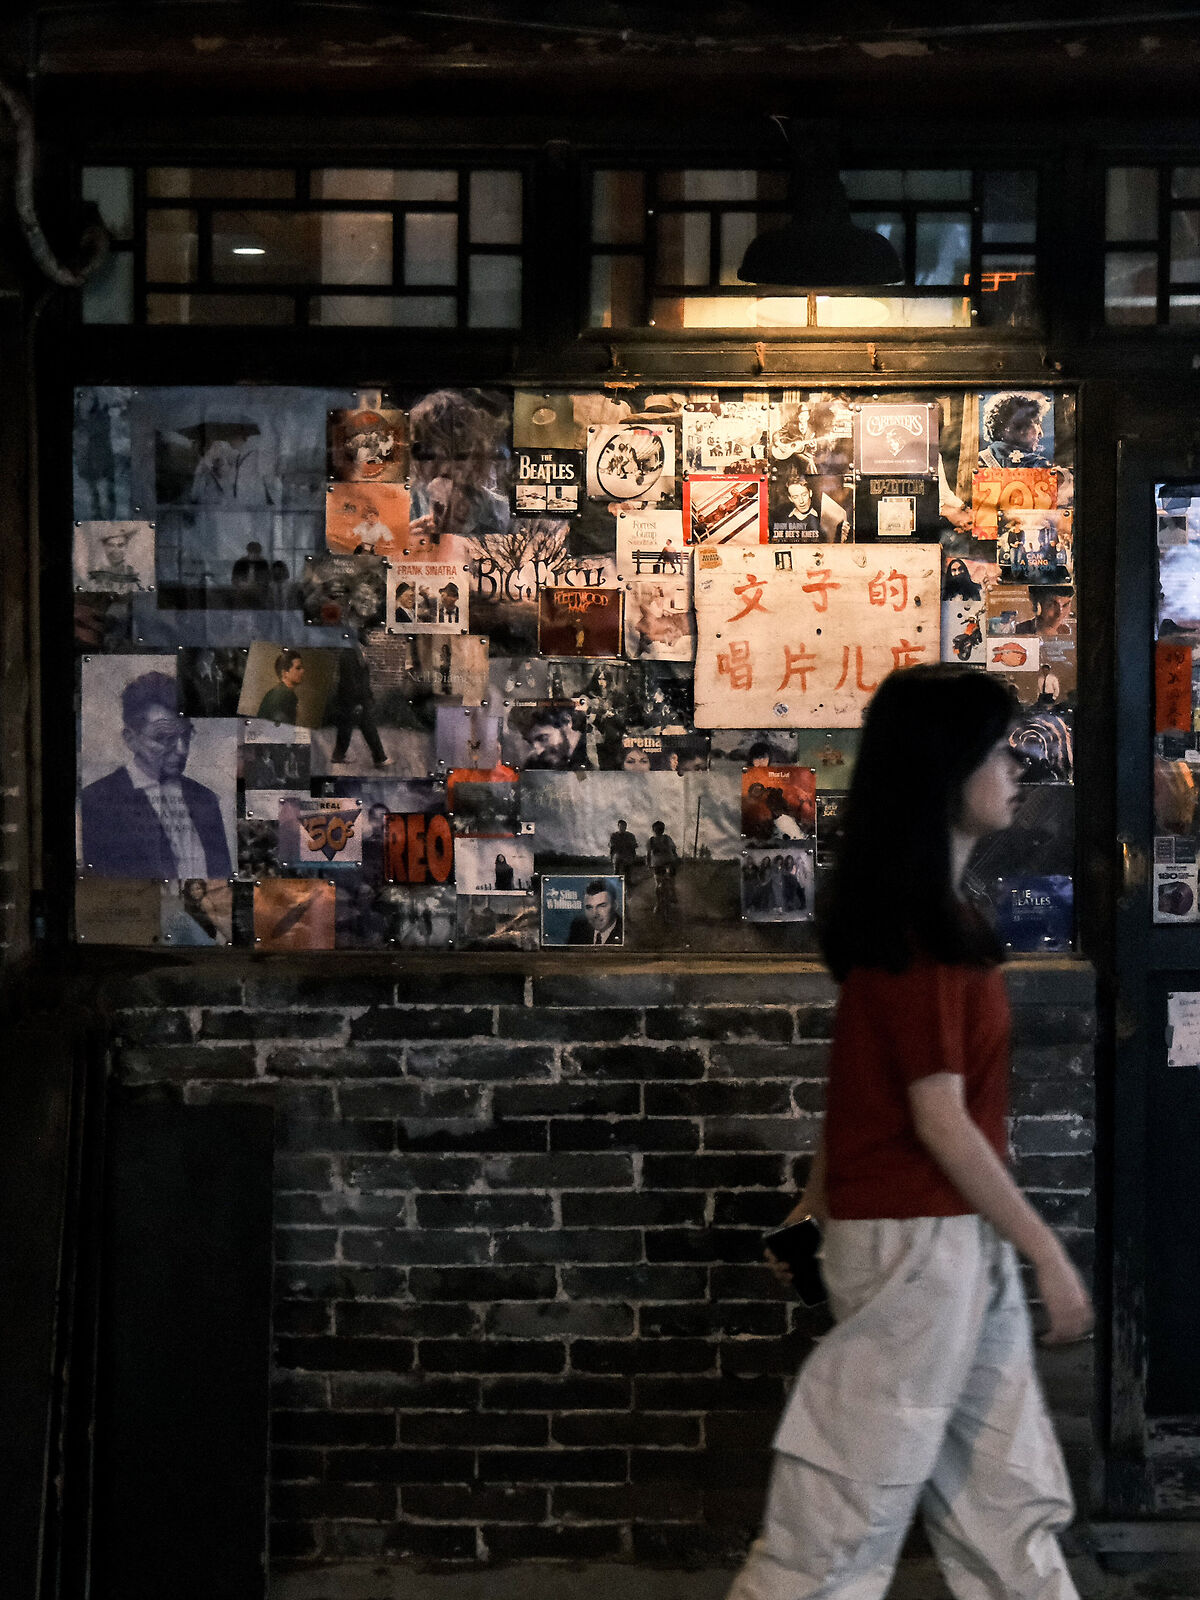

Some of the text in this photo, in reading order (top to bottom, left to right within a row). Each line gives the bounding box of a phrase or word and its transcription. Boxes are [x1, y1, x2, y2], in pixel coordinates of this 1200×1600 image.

[867, 415, 923, 436] CARPENTERS
[632, 521, 656, 529] Forrest
[398, 565, 457, 575] FRANK SINATRA
[727, 568, 908, 622] 文子的
[623, 738, 661, 748] aretha
[385, 814, 451, 882] REO
